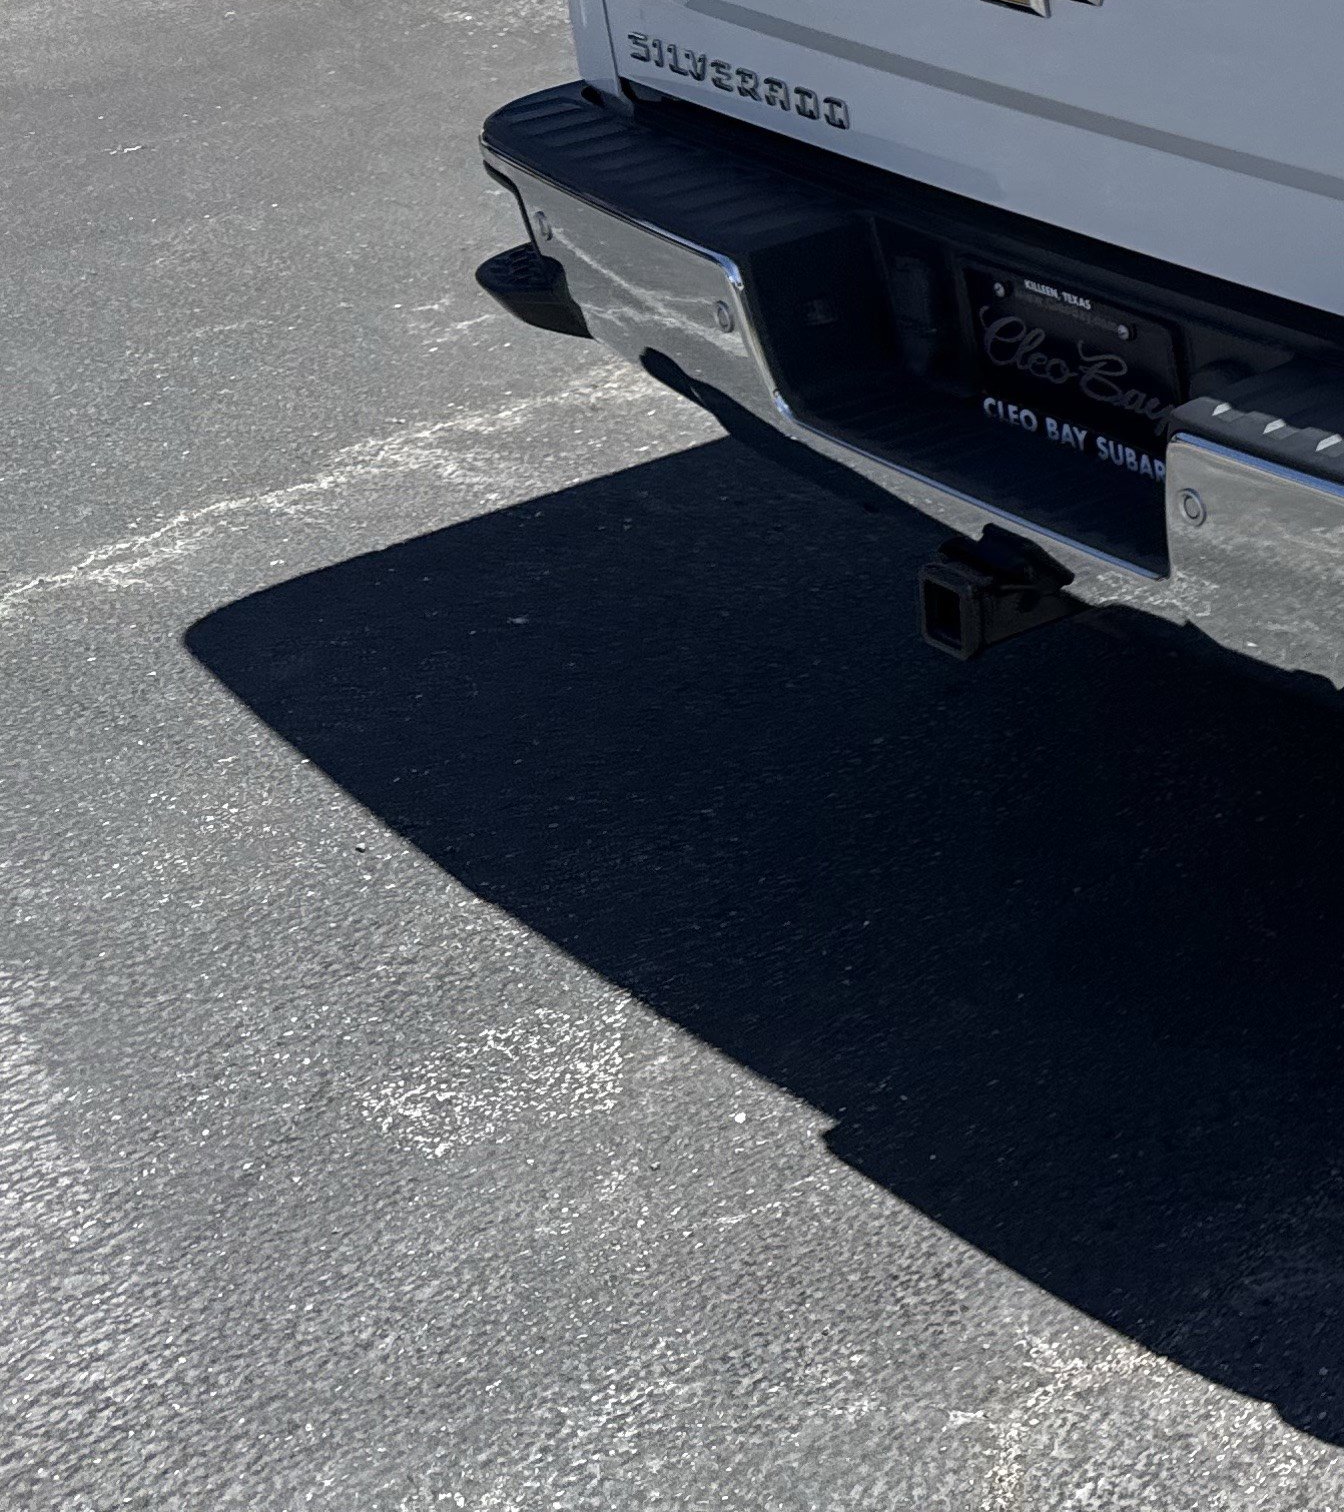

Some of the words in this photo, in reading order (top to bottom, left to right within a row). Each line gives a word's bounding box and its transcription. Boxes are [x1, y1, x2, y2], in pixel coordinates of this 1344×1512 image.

[627, 31, 850, 130] SILVERADO
[1061, 291, 1092, 310] TEXAS
[979, 305, 1078, 384] Cleo
[983, 396, 1039, 433] CLEO
[1044, 416, 1088, 451] BAY
[1096, 435, 1166, 482] SUBAR
